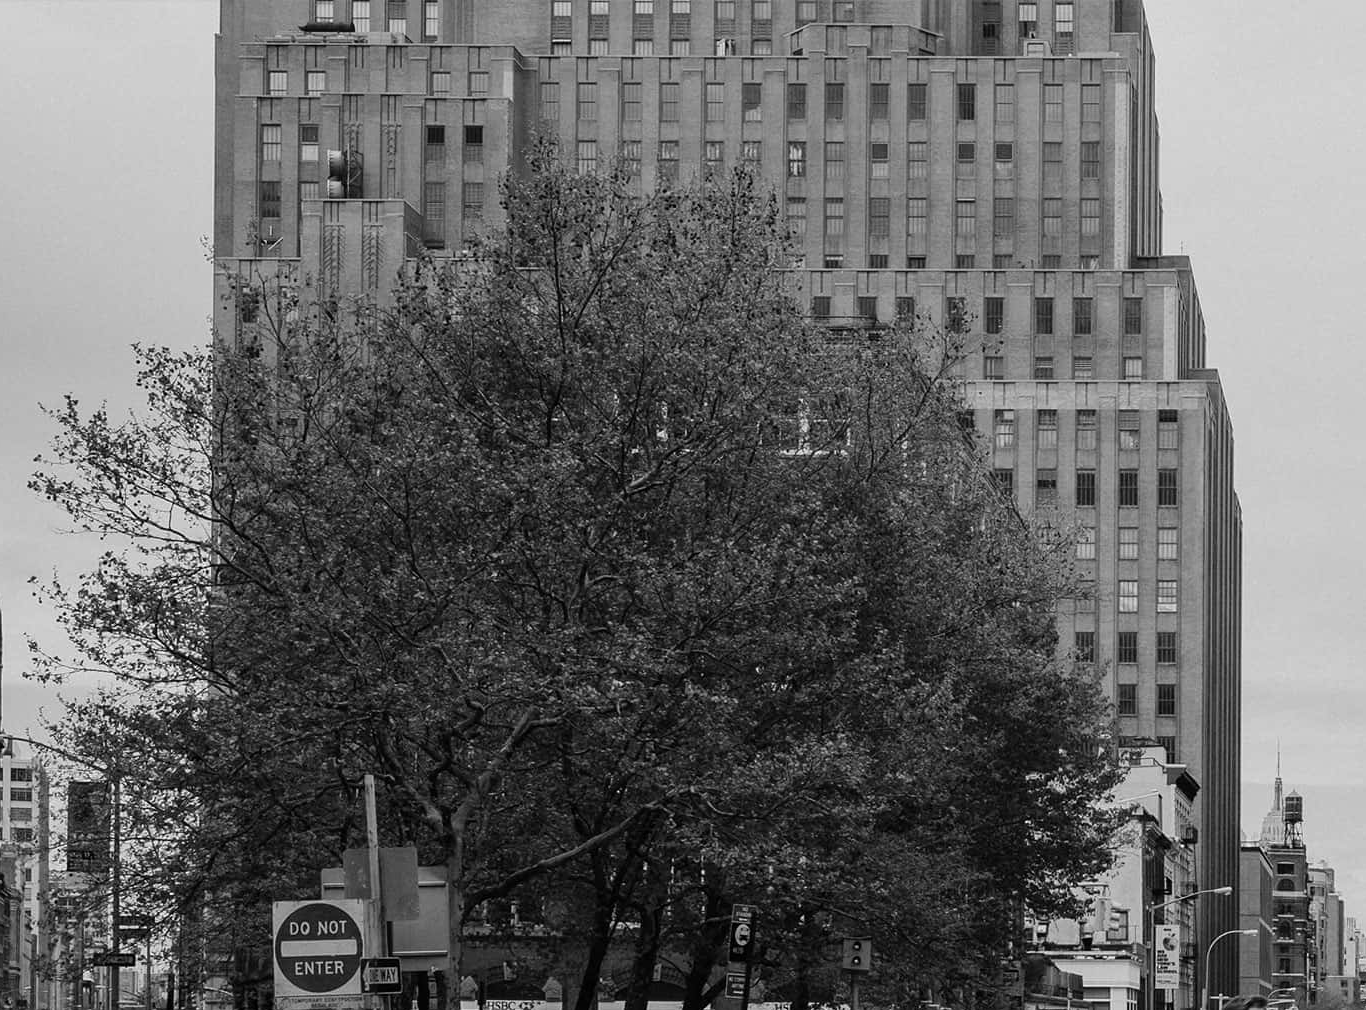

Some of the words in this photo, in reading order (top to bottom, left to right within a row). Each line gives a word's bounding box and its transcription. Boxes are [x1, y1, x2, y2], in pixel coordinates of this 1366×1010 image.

[289, 921, 311, 935] DO
[317, 920, 347, 936] NOT
[295, 960, 344, 976] ENTER
[487, 1001, 516, 1010] HSBC
